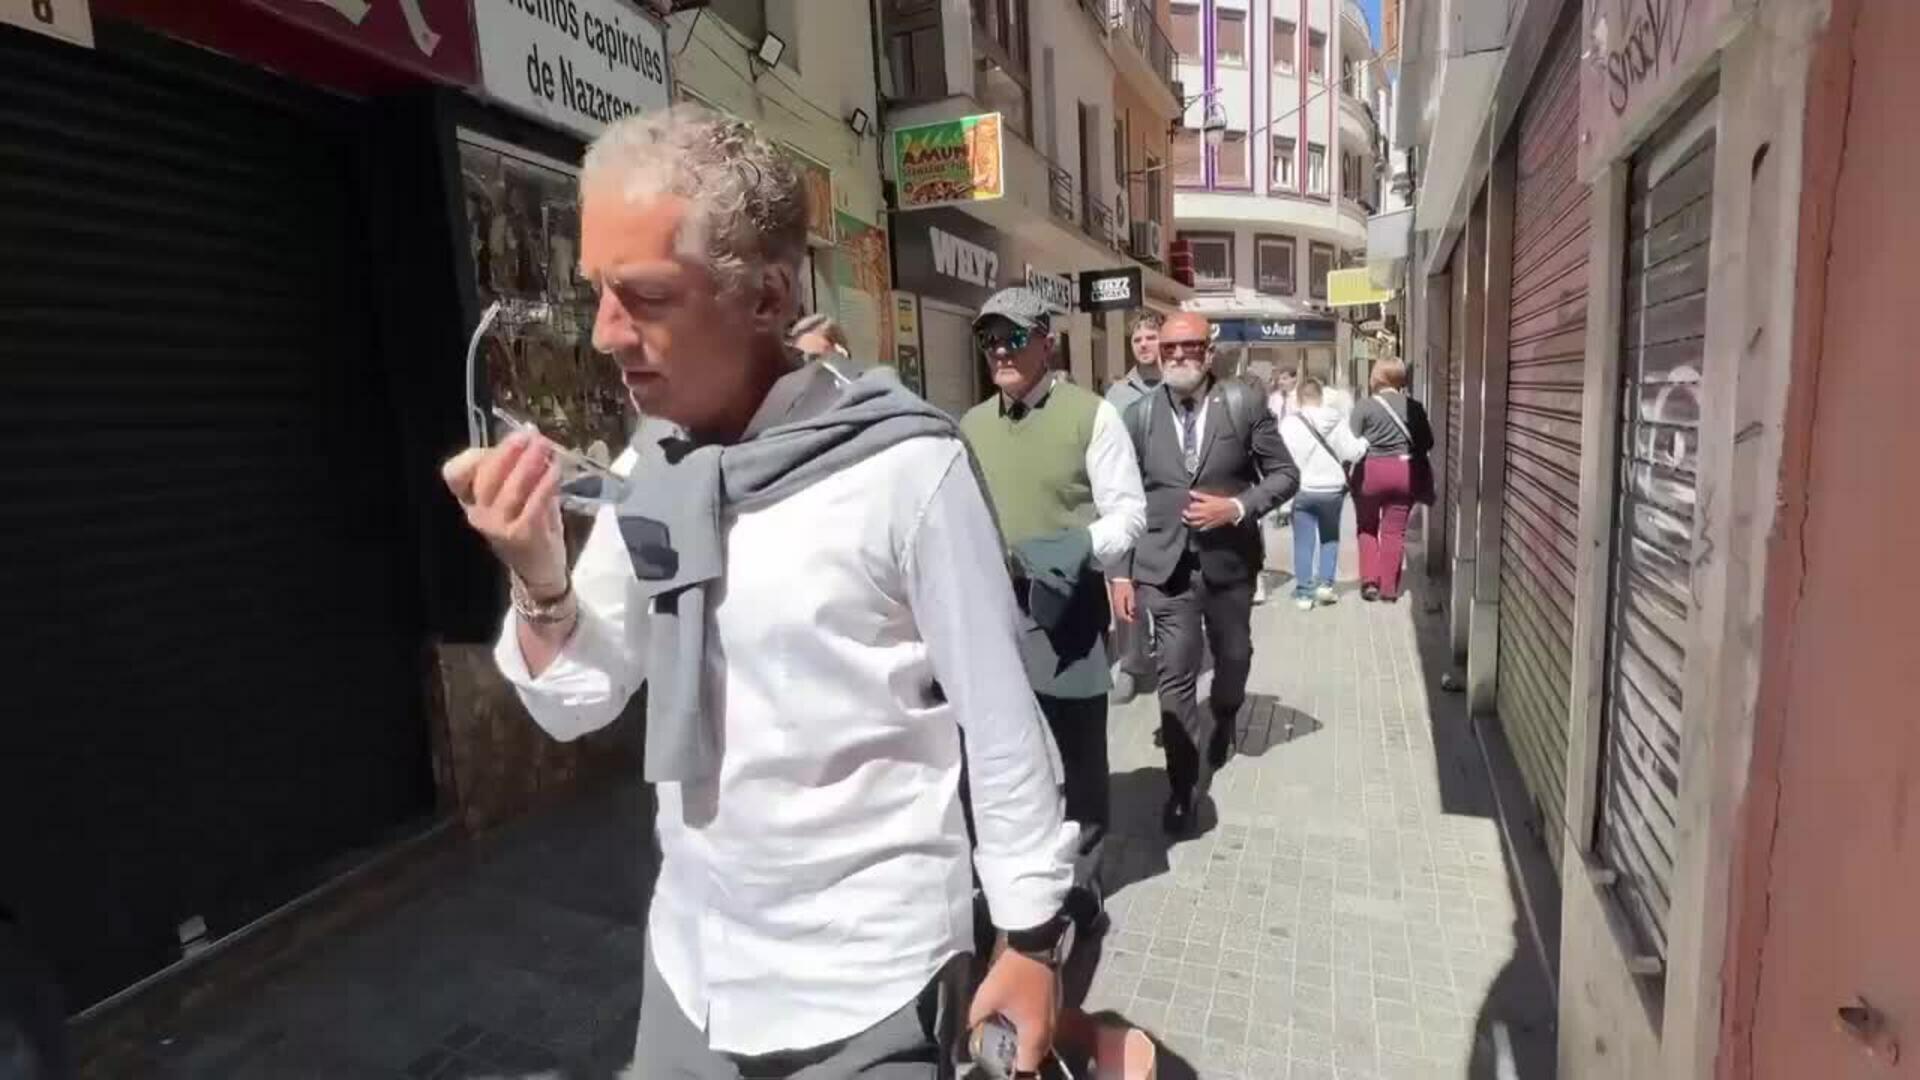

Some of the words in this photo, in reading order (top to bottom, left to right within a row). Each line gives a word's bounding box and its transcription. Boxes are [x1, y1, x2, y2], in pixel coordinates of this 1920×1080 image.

[527, 44, 554, 101] de
[584, 11, 663, 84] capirotes
[929, 226, 999, 289] WHY?
